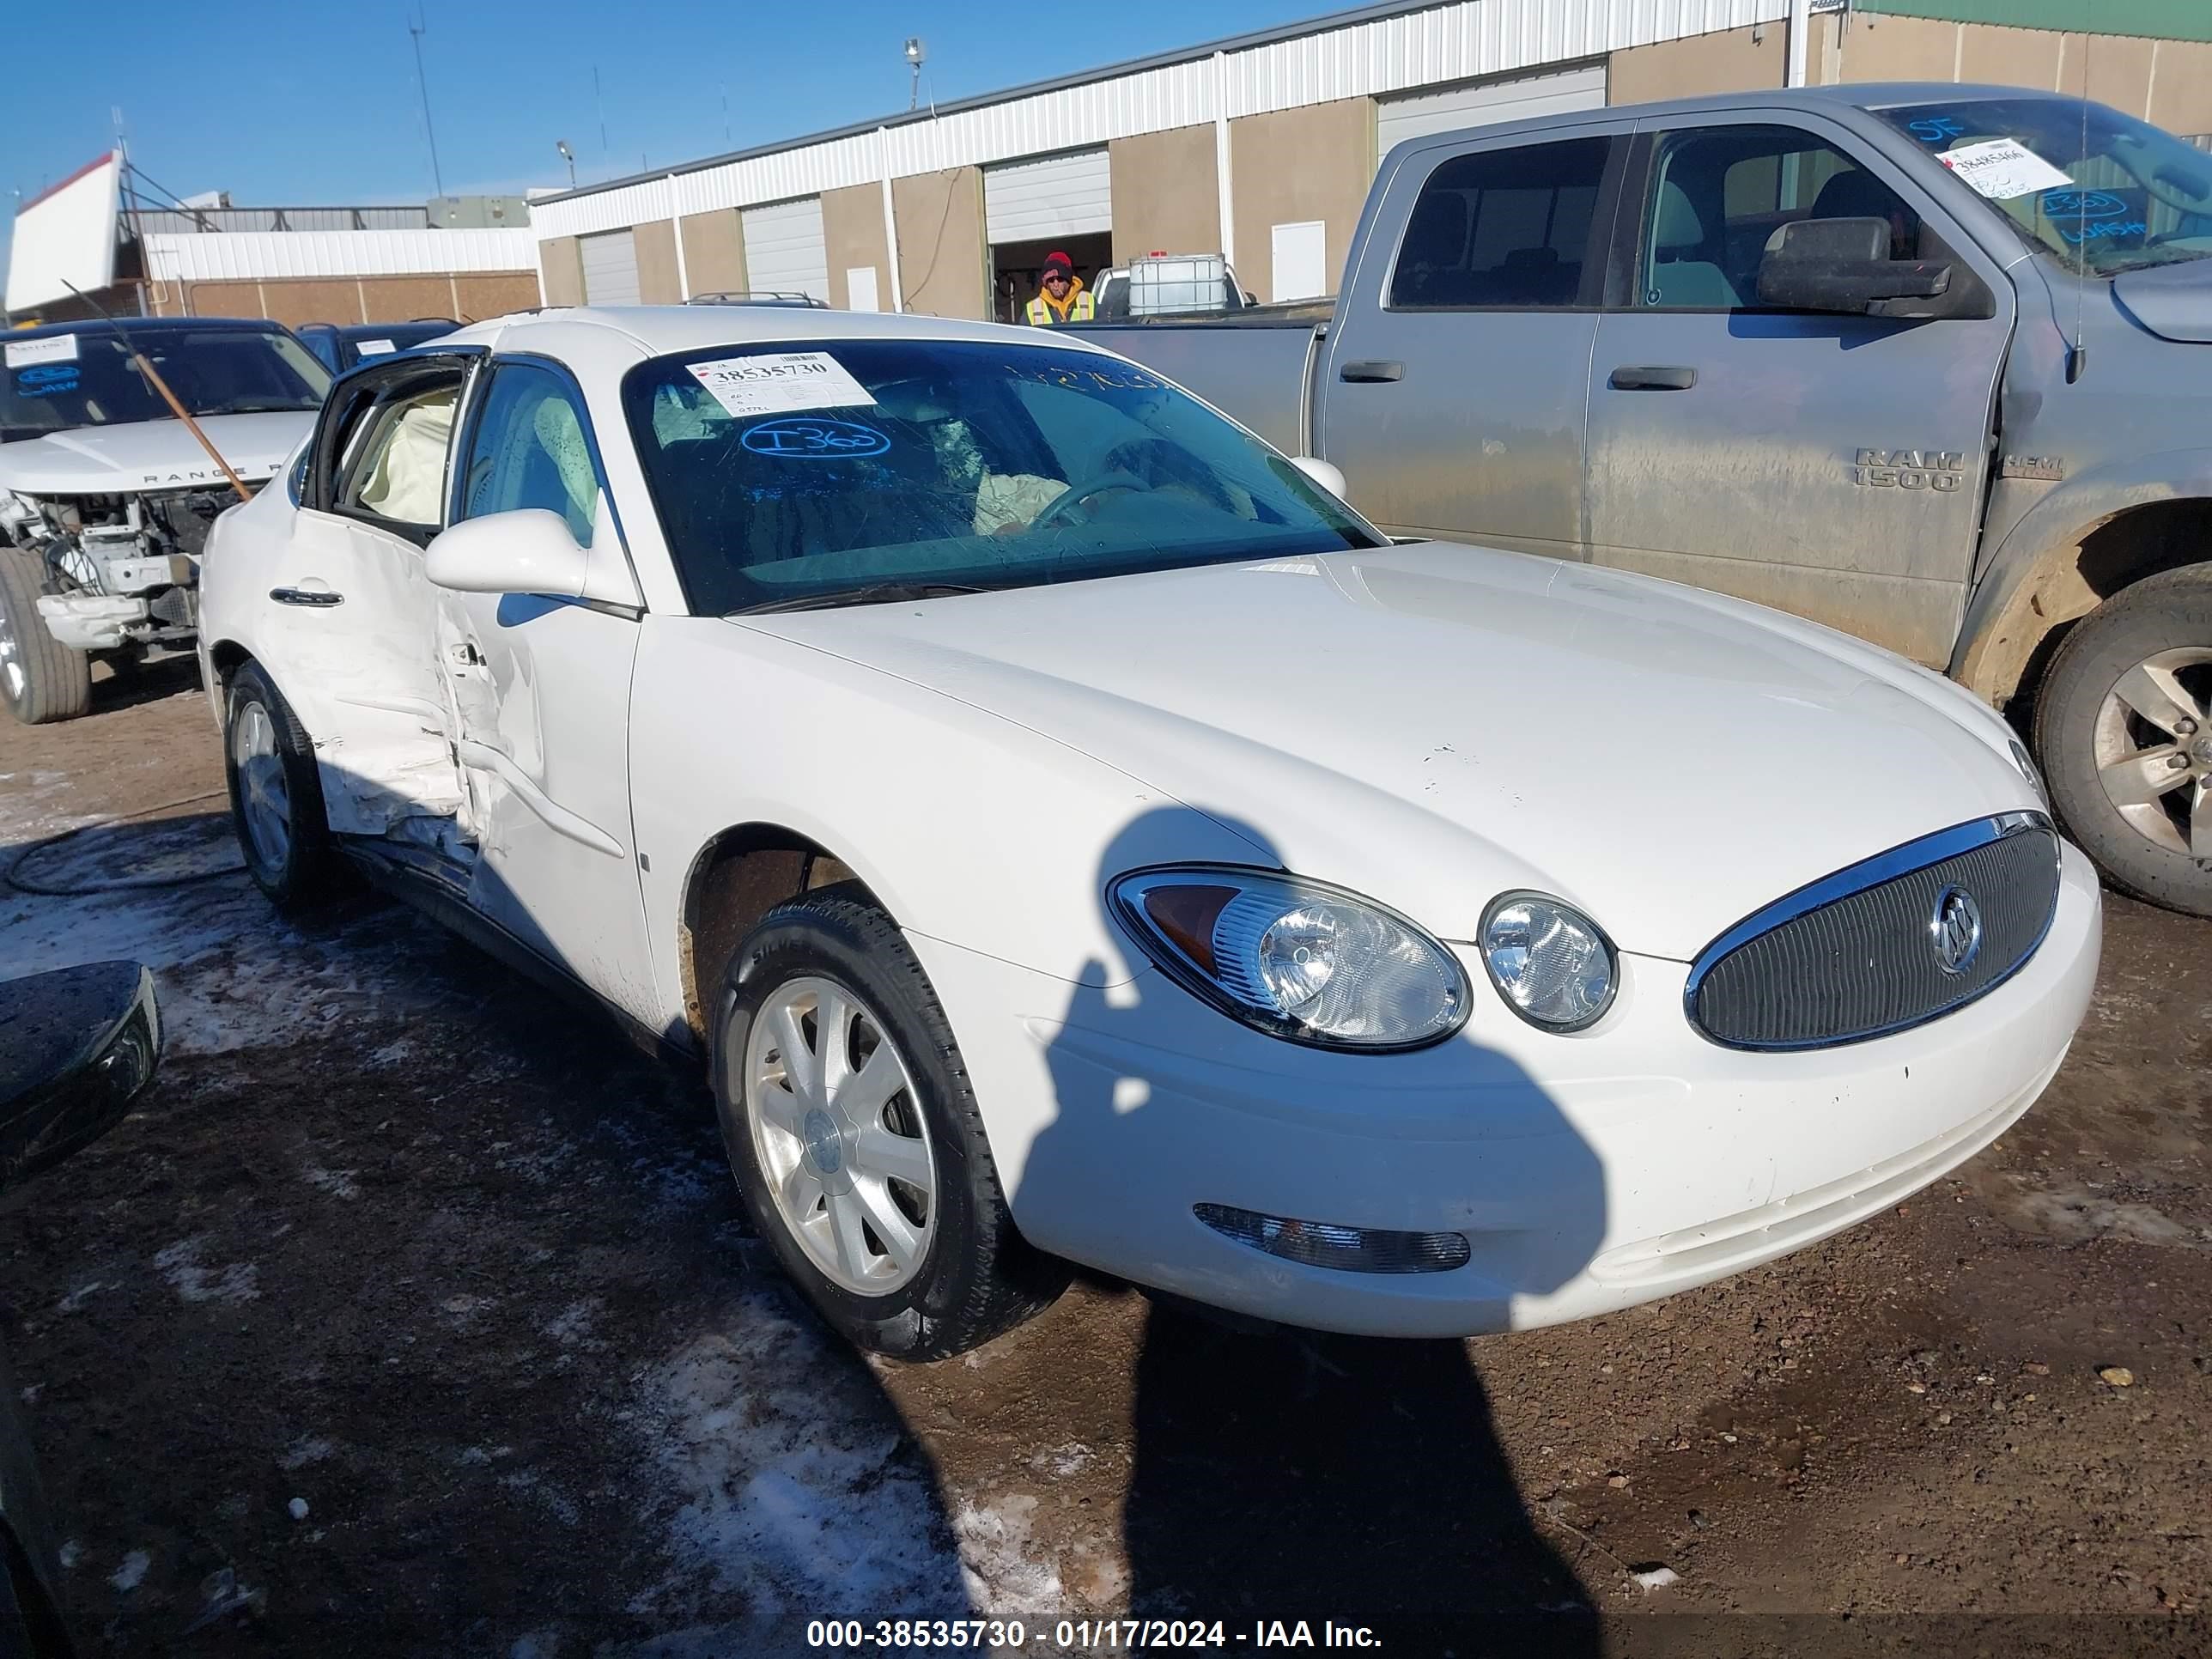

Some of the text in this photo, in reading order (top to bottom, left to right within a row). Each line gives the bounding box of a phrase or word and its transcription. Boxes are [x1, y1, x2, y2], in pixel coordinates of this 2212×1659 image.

[2061, 222, 2146, 242] WASH
[713, 362, 827, 383] 38535730
[1855, 447, 1965, 471] RAM
[2003, 453, 2062, 469] HEMI
[143, 466, 247, 483] RANGE
[1854, 467, 1963, 492] 1500
